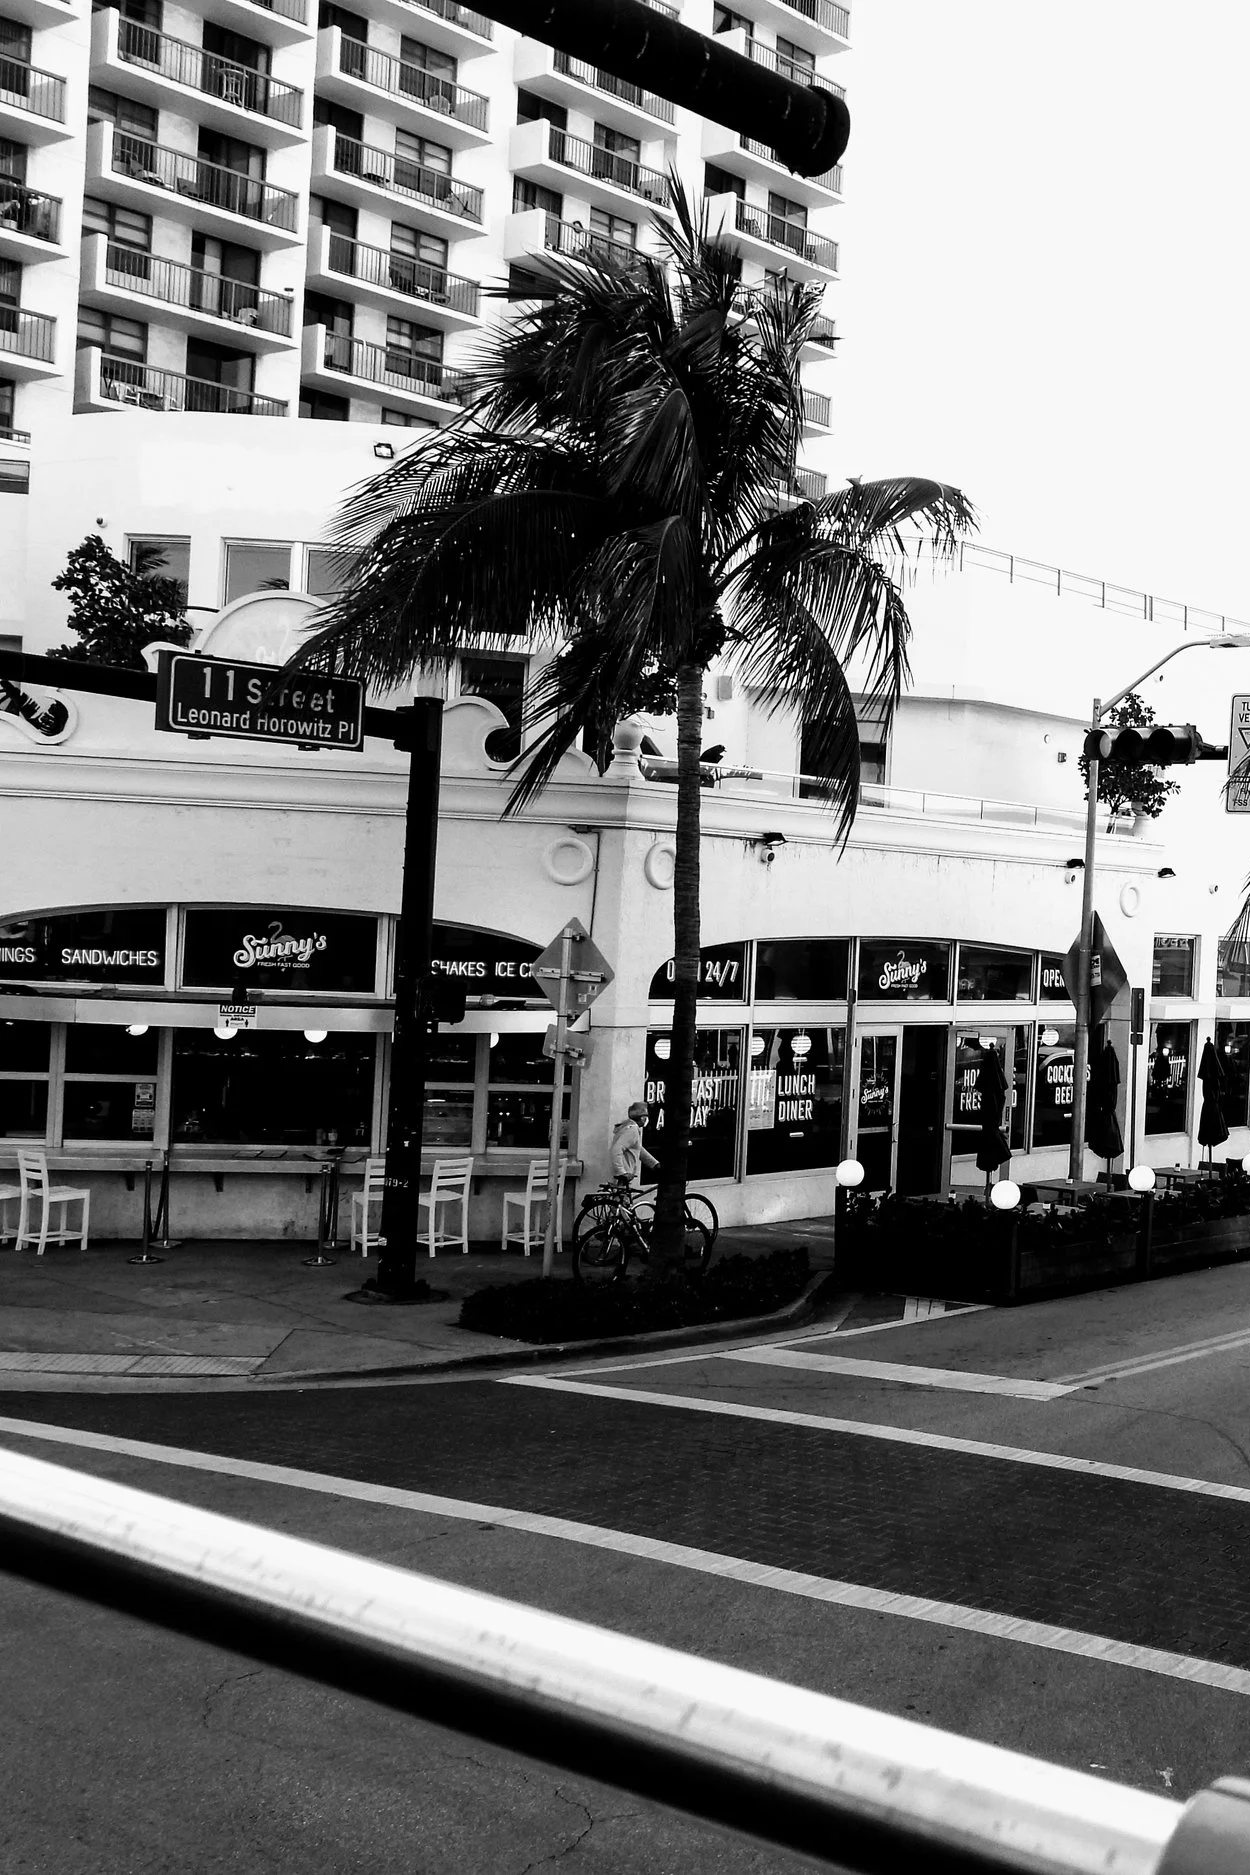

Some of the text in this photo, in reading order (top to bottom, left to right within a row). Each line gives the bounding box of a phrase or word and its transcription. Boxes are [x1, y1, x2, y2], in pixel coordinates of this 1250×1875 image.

[203, 666, 235, 701] 11
[177, 702, 250, 729] Leonard
[257, 711, 332, 738] Horowitz
[0, 947, 36, 963] INGS
[61, 948, 158, 966] SANDWICHES
[233, 932, 327, 968] Sunny's
[430, 960, 486, 977] SHAKES
[495, 961, 516, 977] ICE
[704, 959, 740, 987] 24/7
[878, 958, 927, 990] Sunny's
[220, 1004, 255, 1014] NOTICE
[778, 1074, 816, 1096] LUNCH
[860, 1086, 889, 1104] Sunny's
[778, 1099, 813, 1122] DINER
